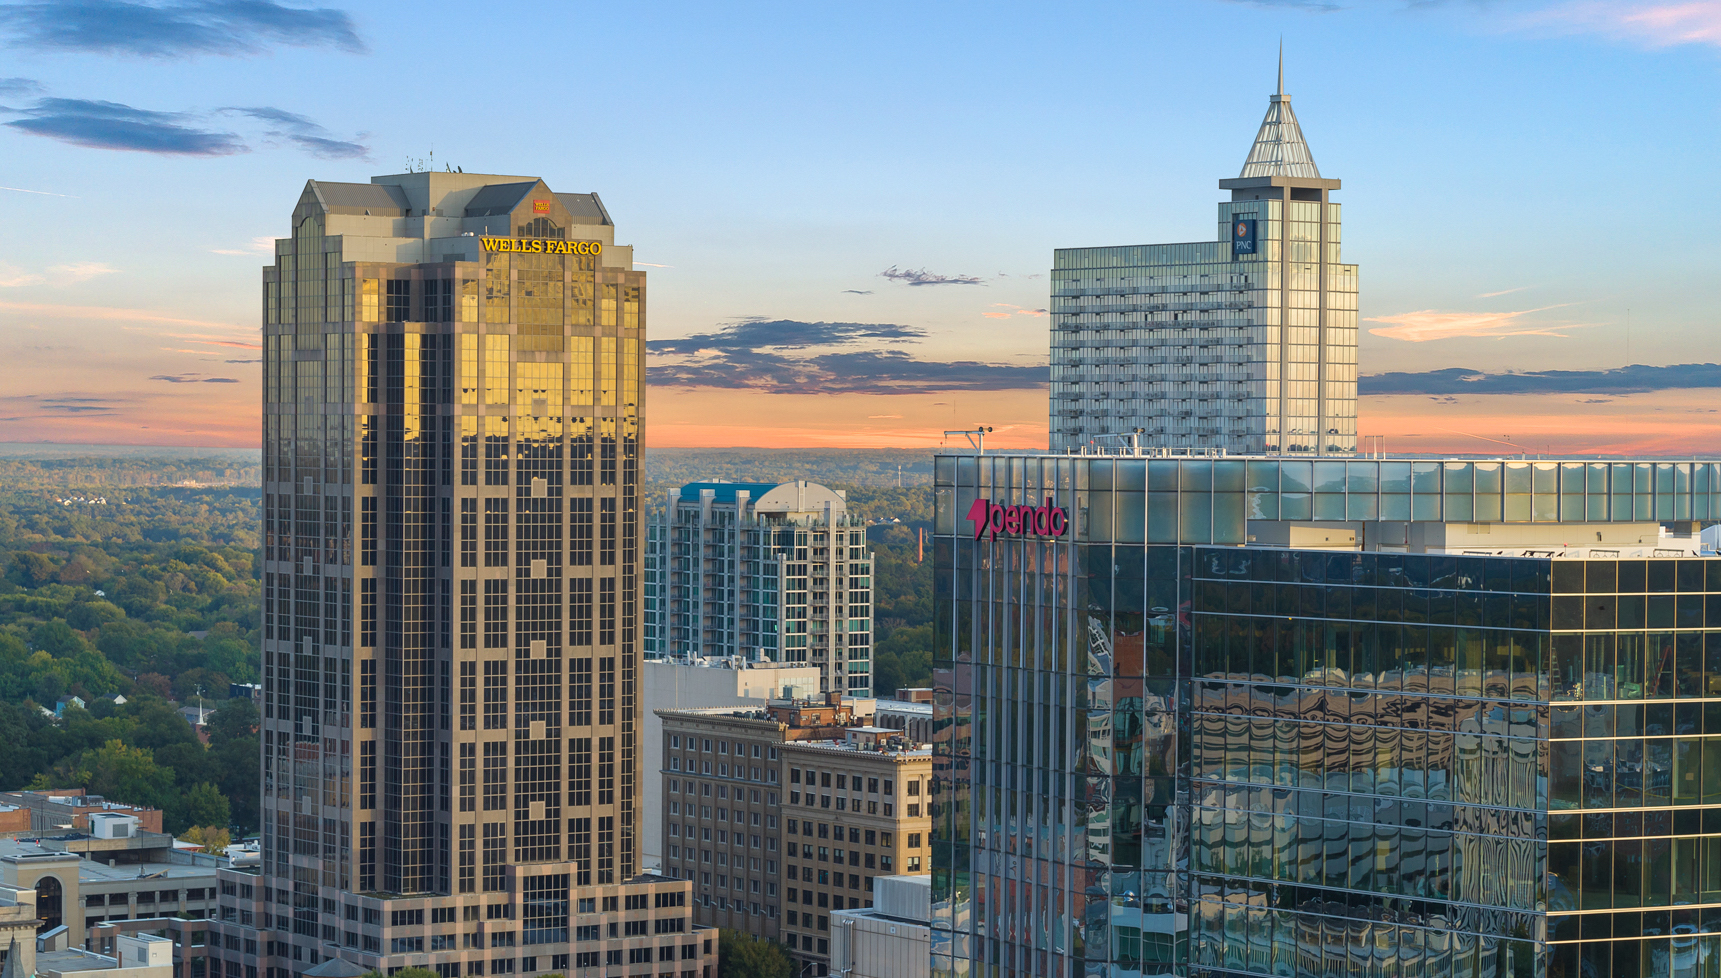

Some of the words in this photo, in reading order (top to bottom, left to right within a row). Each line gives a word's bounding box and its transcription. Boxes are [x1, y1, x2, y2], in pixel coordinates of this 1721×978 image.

[481, 238, 542, 253] WELLS
[545, 240, 602, 255] FARGO
[1236, 240, 1252, 250] PNC
[990, 496, 1067, 543] pendo
